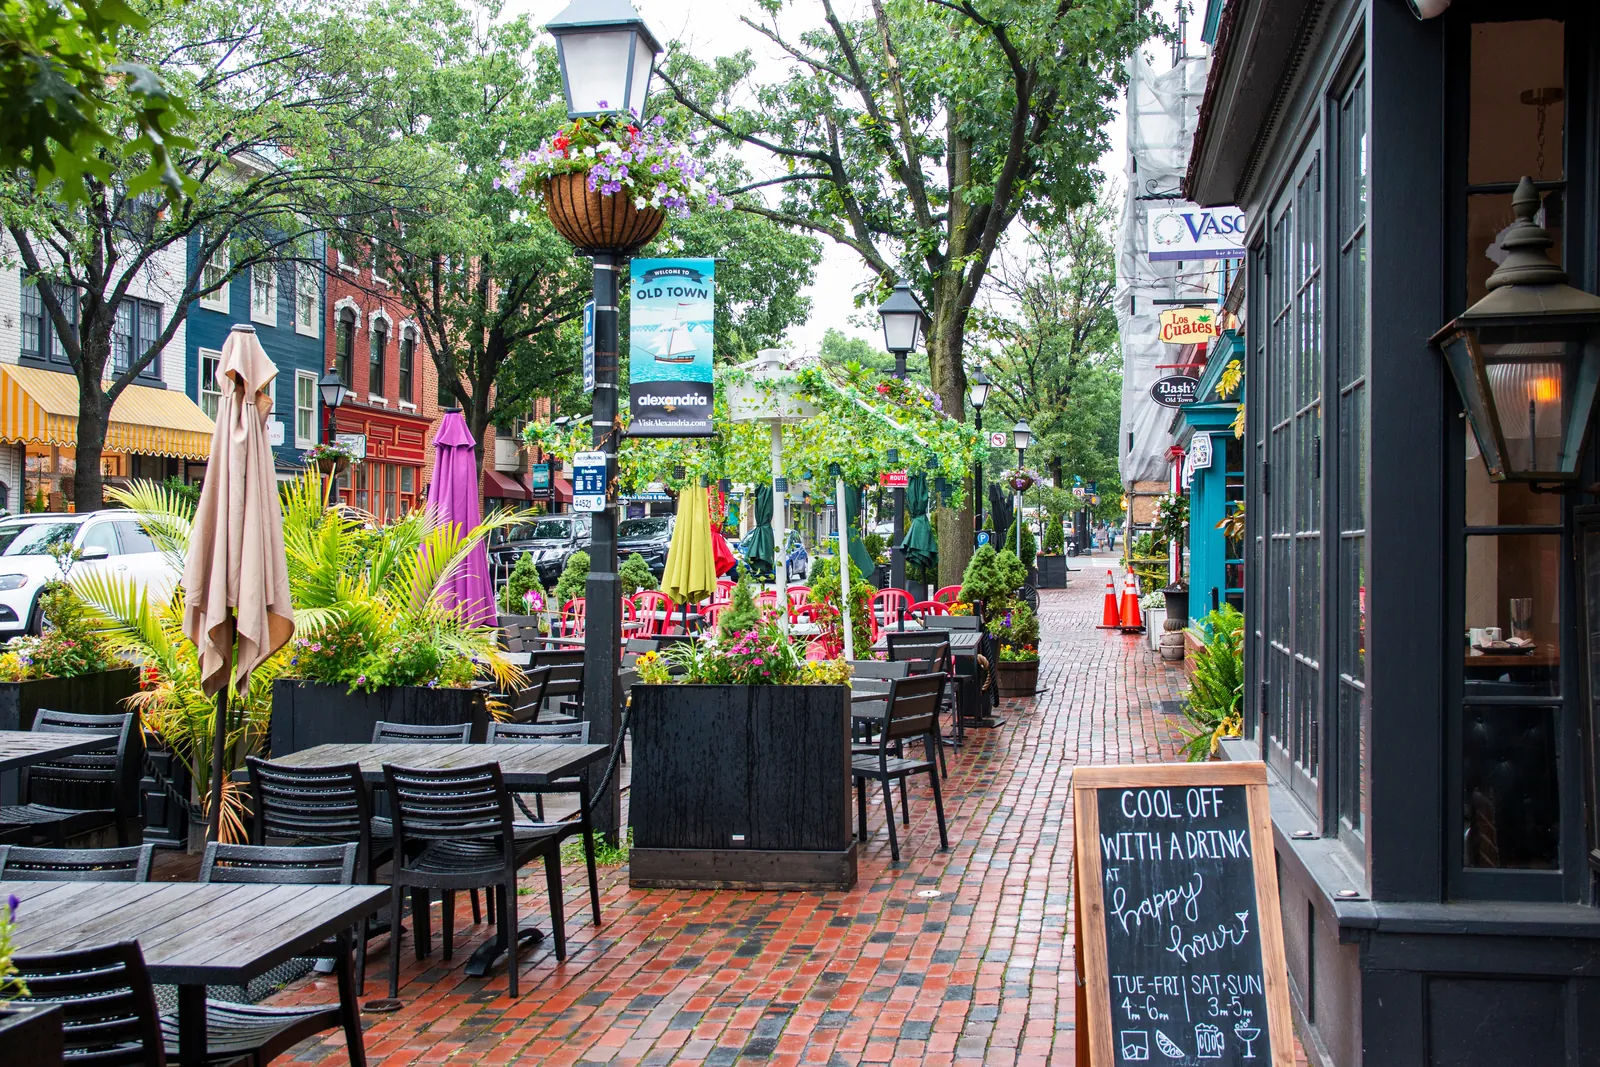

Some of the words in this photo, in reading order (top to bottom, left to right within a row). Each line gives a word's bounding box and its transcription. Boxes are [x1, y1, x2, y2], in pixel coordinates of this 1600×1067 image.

[636, 287, 663, 300] OLD
[667, 287, 708, 300] TOWN
[1172, 313, 1189, 325] Los
[1163, 321, 1213, 340] Cuates
[638, 392, 707, 406] alexandria
[638, 419, 707, 427] VisitAlexandria.com
[1121, 789, 1182, 818] COOL
[1186, 788, 1224, 818] OFF
[1100, 832, 1162, 861] WITH
[1169, 832, 1184, 860] A
[1186, 829, 1250, 860] DRINK
[1105, 868, 1120, 882] AT
[1110, 872, 1203, 936] happy
[1166, 925, 1245, 963] hour
[1113, 975, 1180, 995] TUE-FRI
